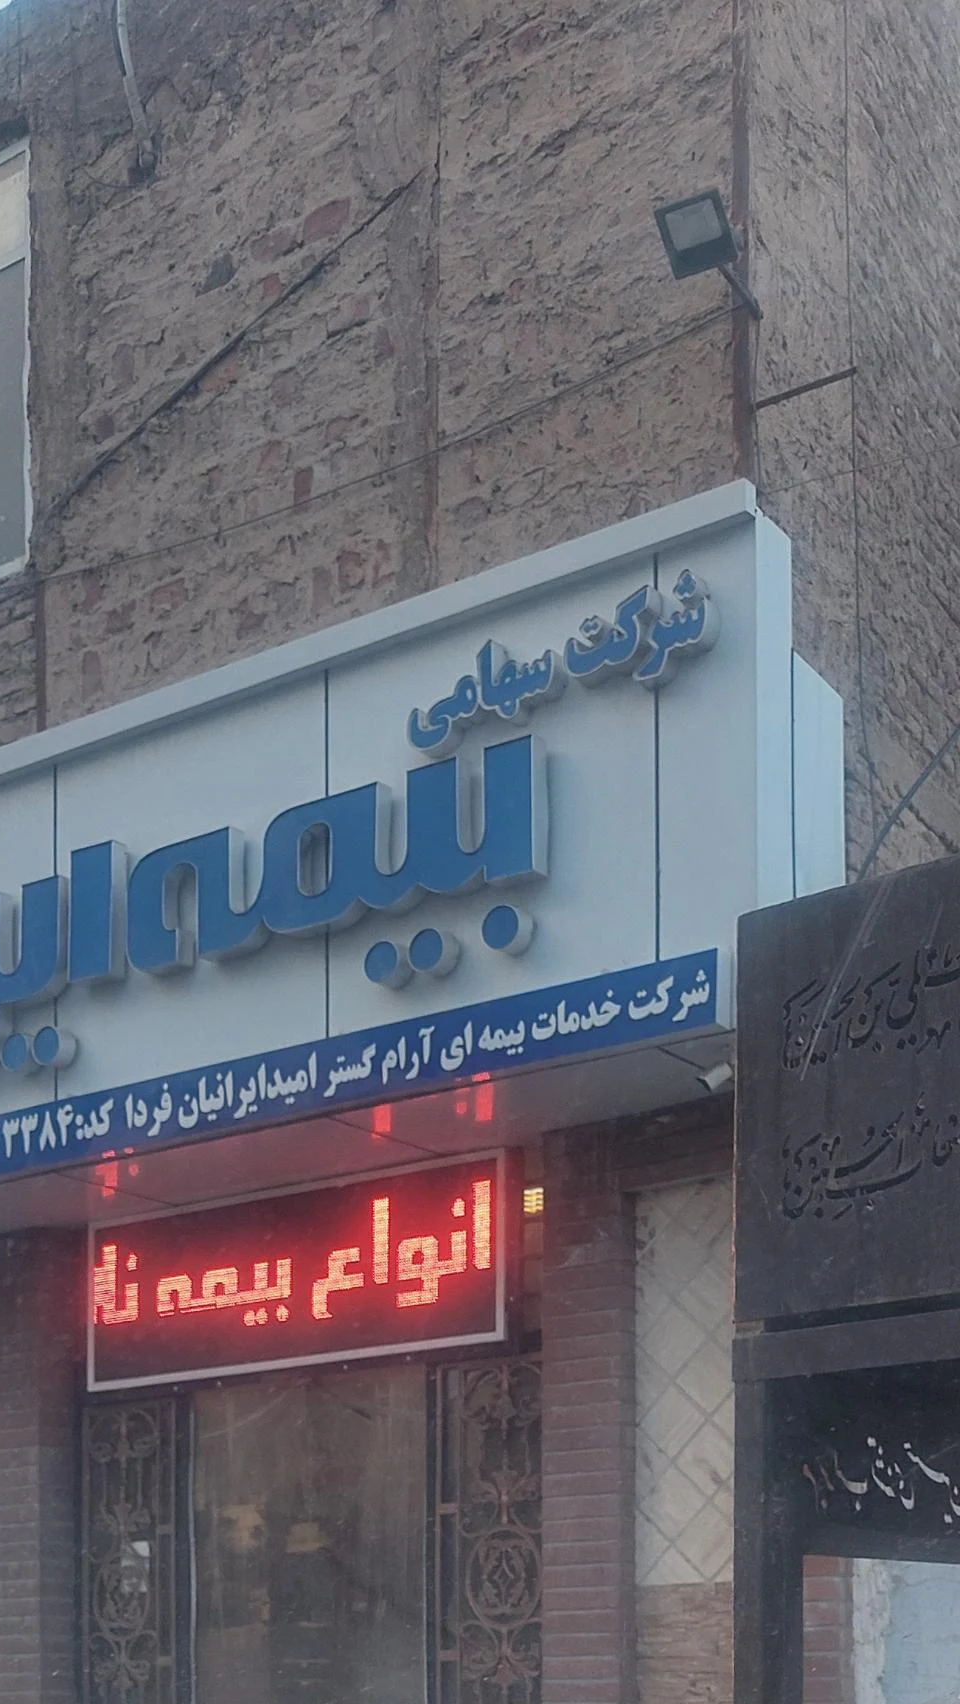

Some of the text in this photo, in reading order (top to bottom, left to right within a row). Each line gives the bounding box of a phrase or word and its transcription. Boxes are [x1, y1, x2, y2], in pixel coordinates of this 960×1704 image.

[406, 569, 713, 753] شرکت سهامی
[127, 735, 548, 985] بیمه
[531, 989, 620, 1038] خدمات
[628, 969, 711, 1022] شرکت
[381, 1026, 435, 1085] آرام
[440, 1022, 473, 1071] ای
[478, 1020, 526, 1054] بیمه
[323, 1044, 377, 1097] گستر
[125, 1083, 173, 1137] فردا
[311, 1179, 491, 1321] انواع
[156, 1258, 293, 1327] بیمه
